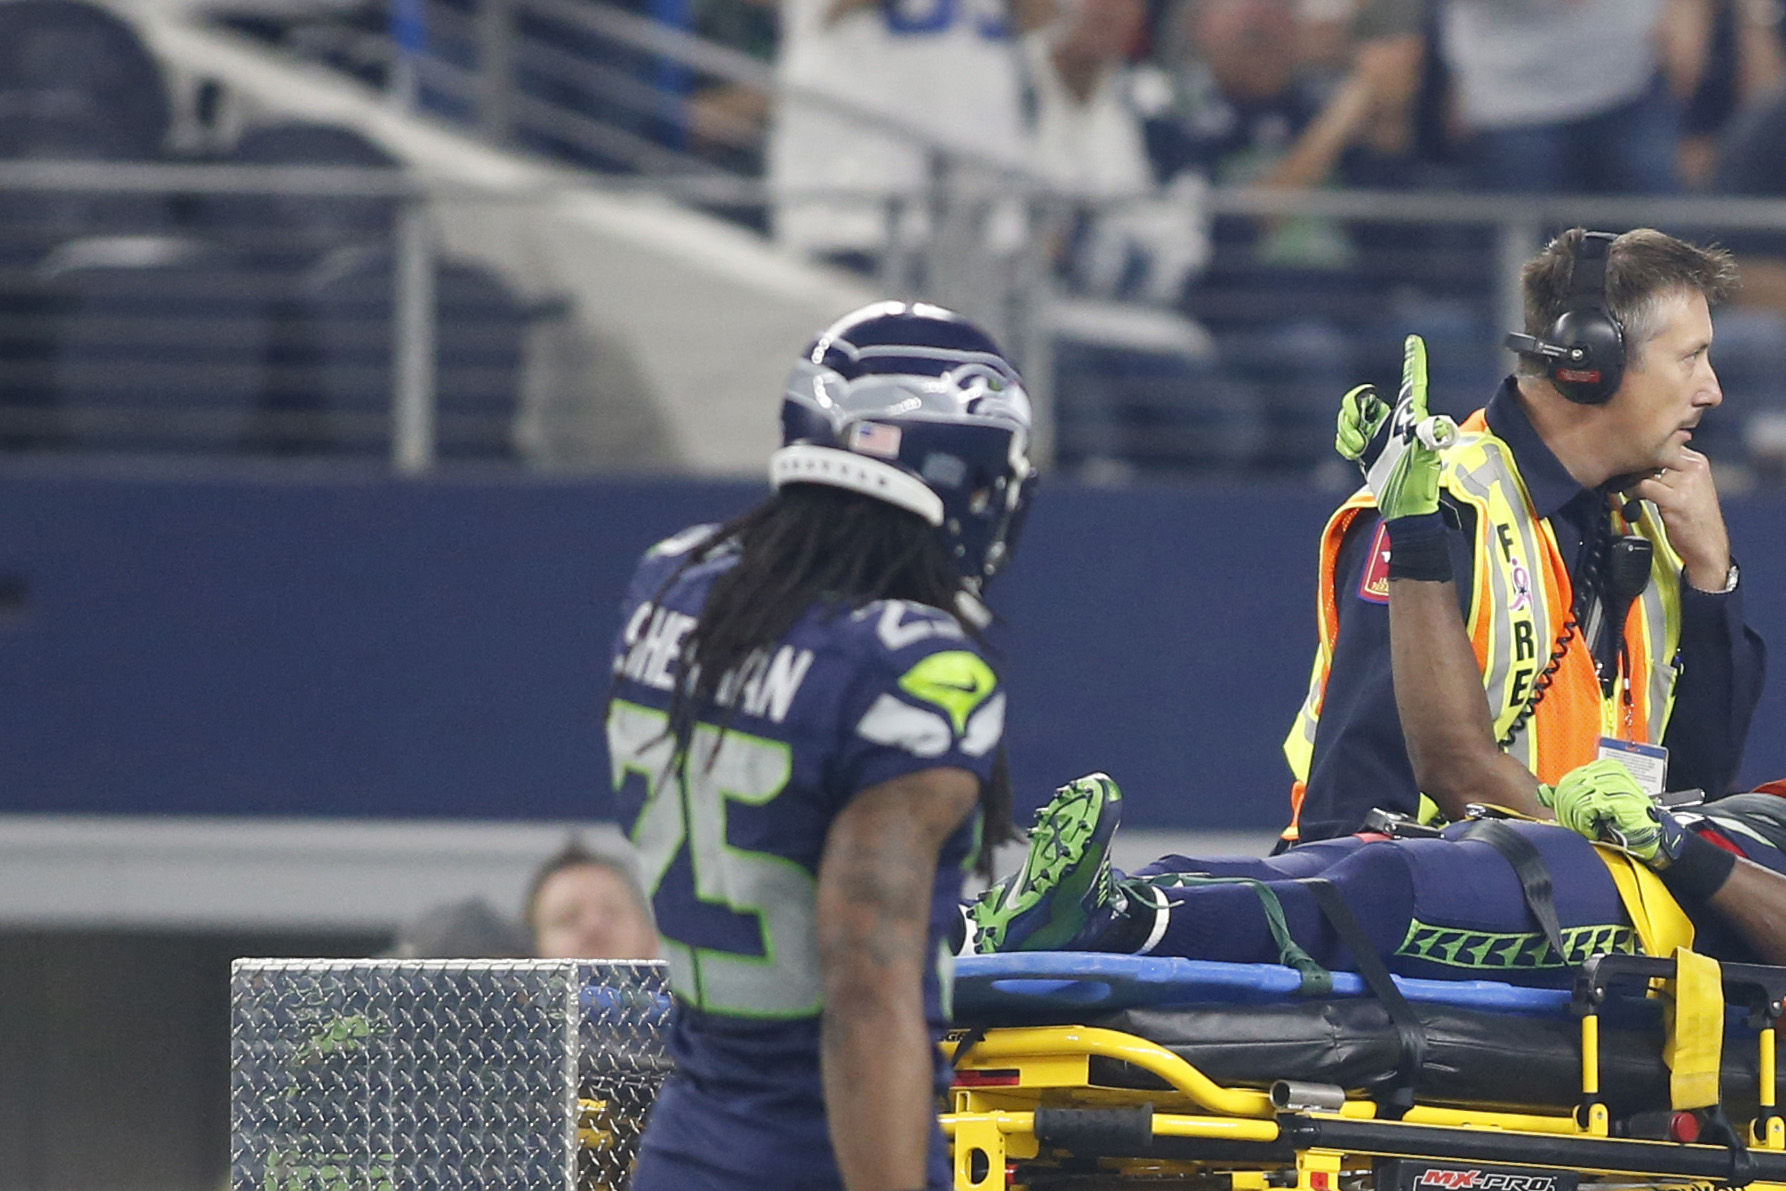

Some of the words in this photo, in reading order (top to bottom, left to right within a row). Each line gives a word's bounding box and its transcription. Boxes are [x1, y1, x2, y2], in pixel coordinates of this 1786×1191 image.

[613, 600, 814, 724] SHEAN
[1497, 523, 1535, 707] FRE
[607, 697, 826, 1020] 25
